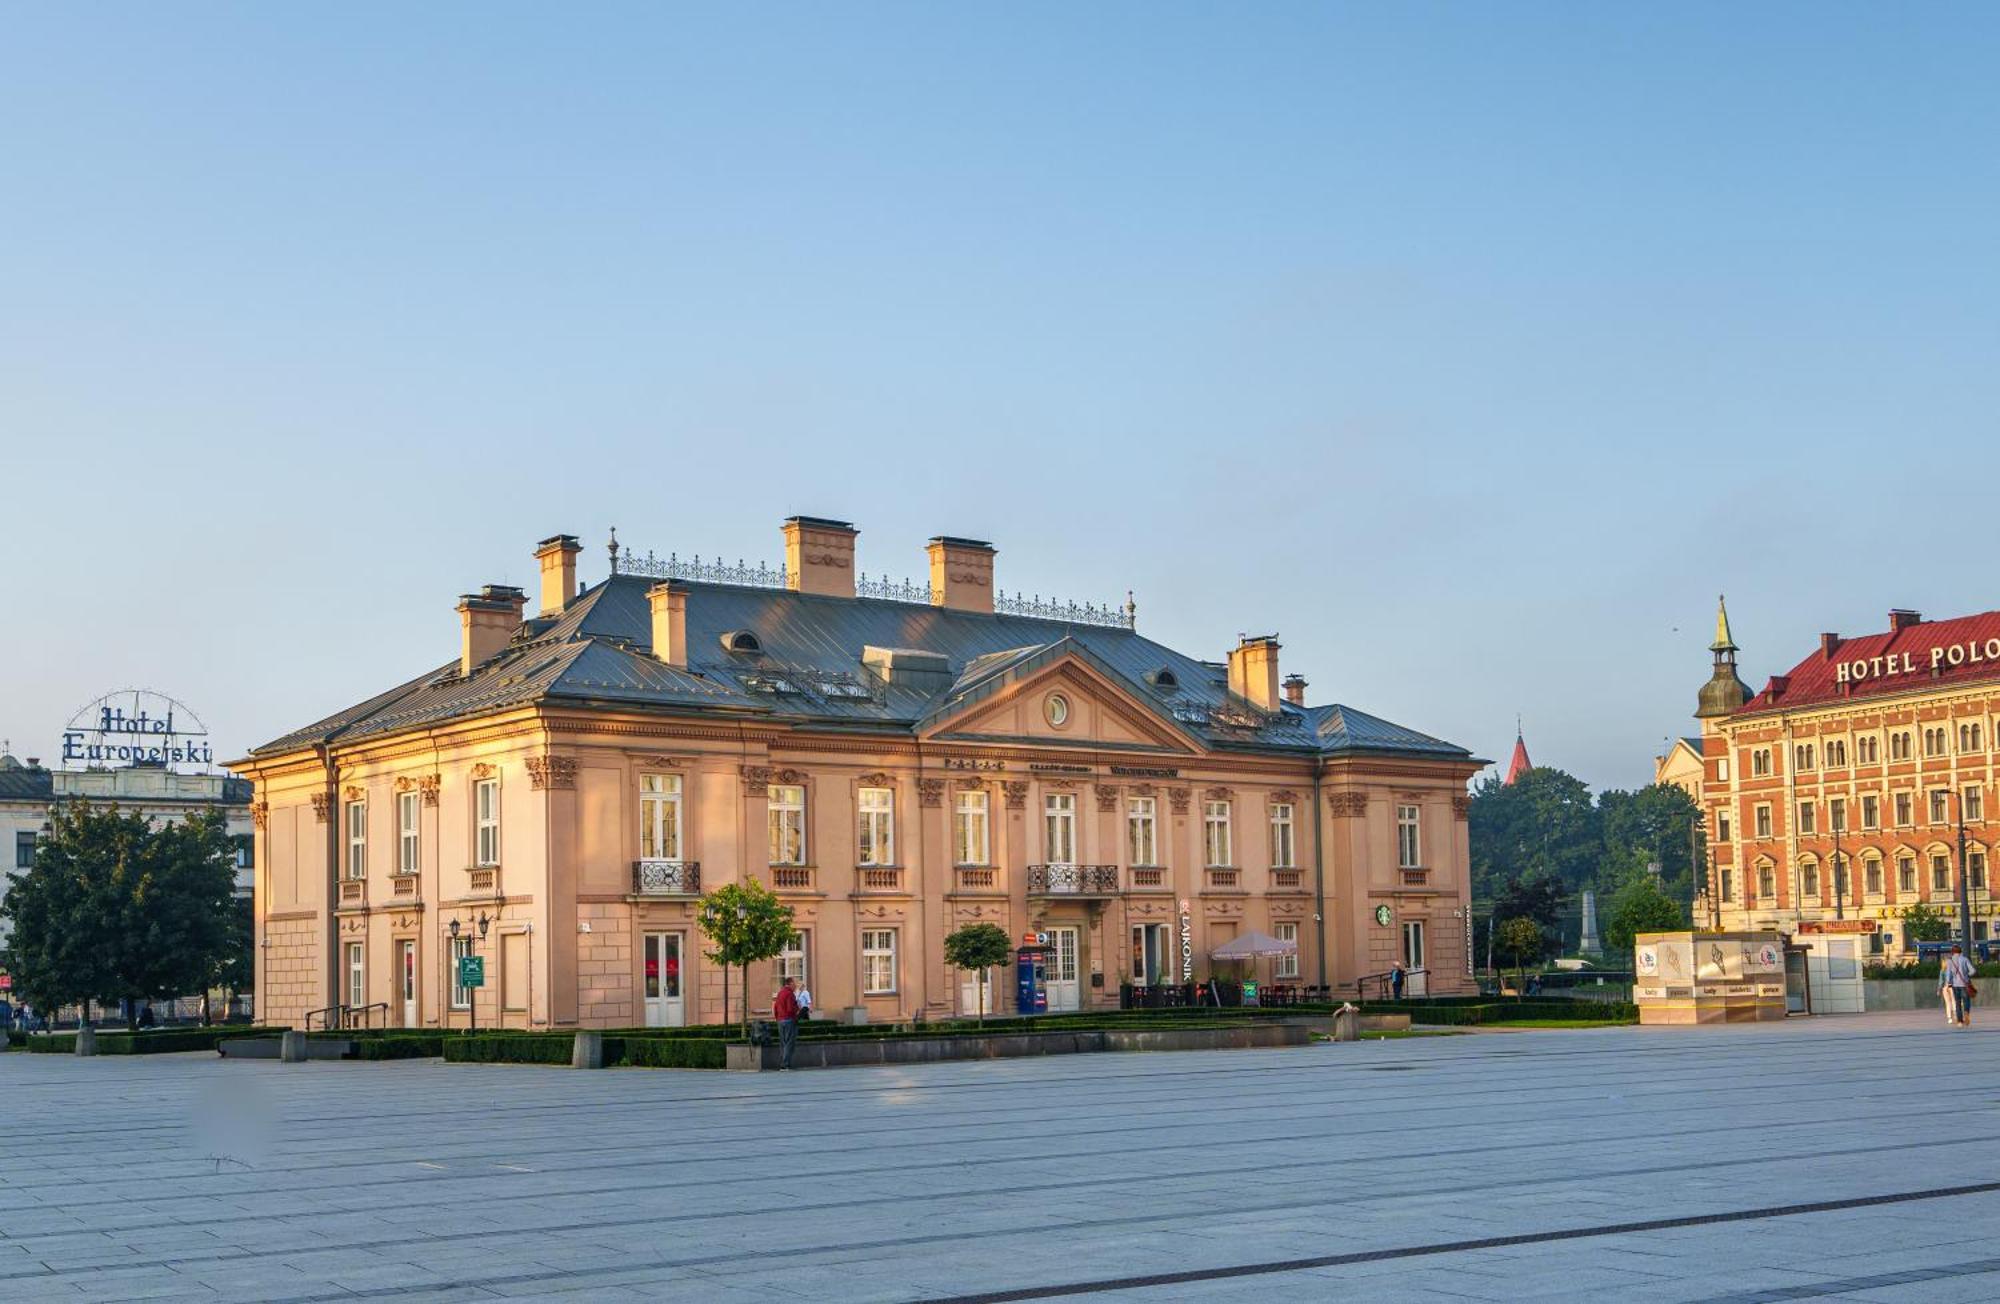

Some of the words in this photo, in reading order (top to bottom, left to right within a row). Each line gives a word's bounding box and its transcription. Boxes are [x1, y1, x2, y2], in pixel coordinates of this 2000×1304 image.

[1836, 652, 1916, 682] HOTEL
[101, 706, 174, 735] Hotel
[63, 733, 212, 768] Europejski
[1181, 916, 1192, 981] LAJKONIK
